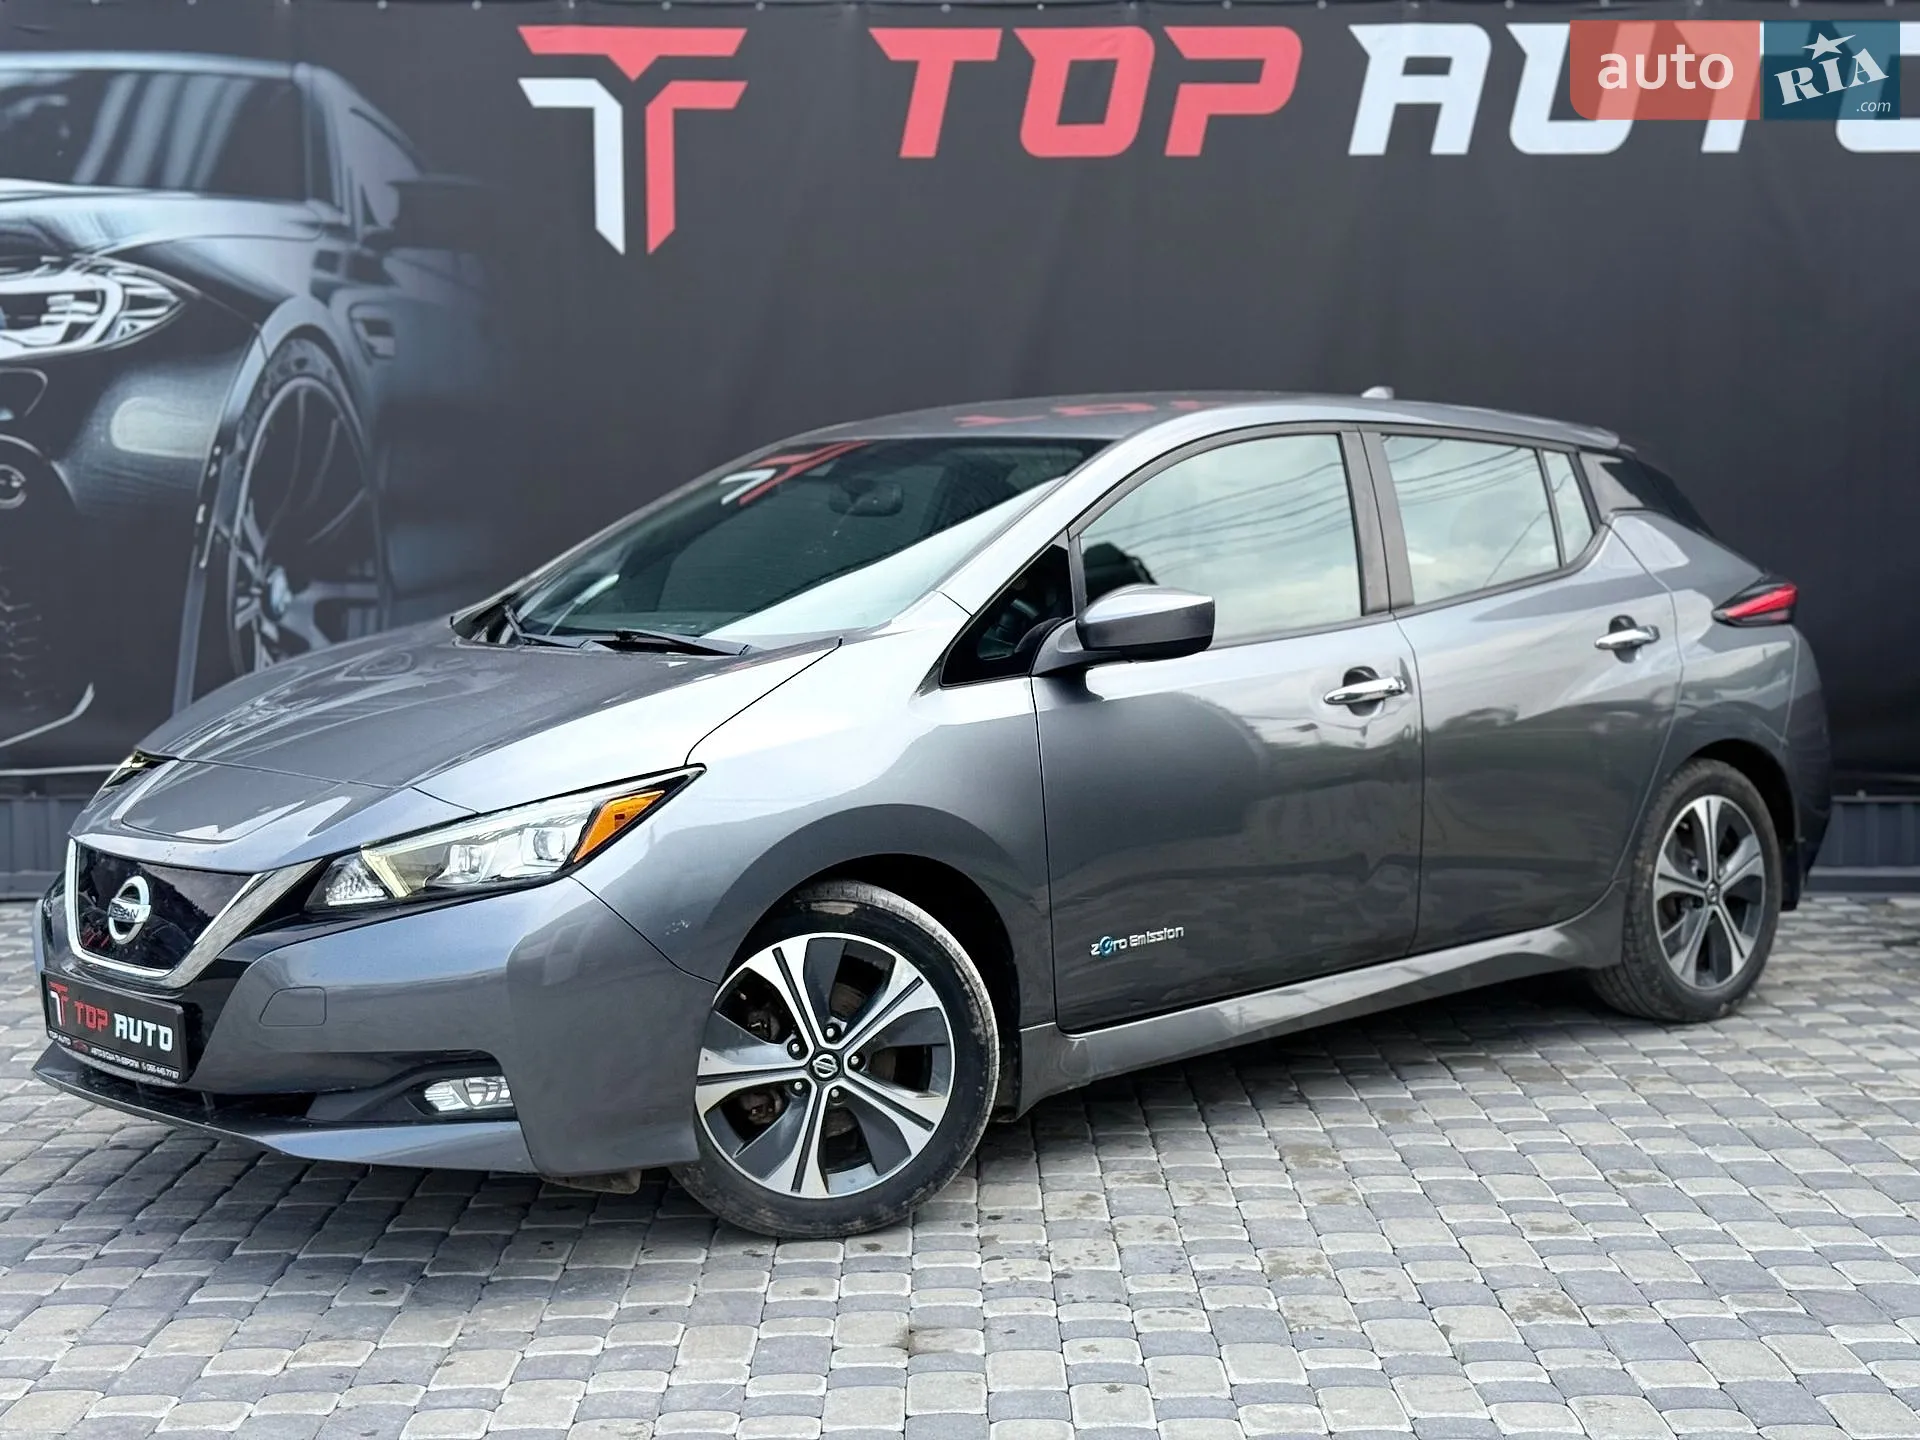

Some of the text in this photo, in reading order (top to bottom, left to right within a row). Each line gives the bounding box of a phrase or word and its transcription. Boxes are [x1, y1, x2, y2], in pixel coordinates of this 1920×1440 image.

[868, 26, 1303, 157] TOP
[1129, 926, 1184, 947] Emission
[74, 1001, 173, 1051] TOP AUTO
